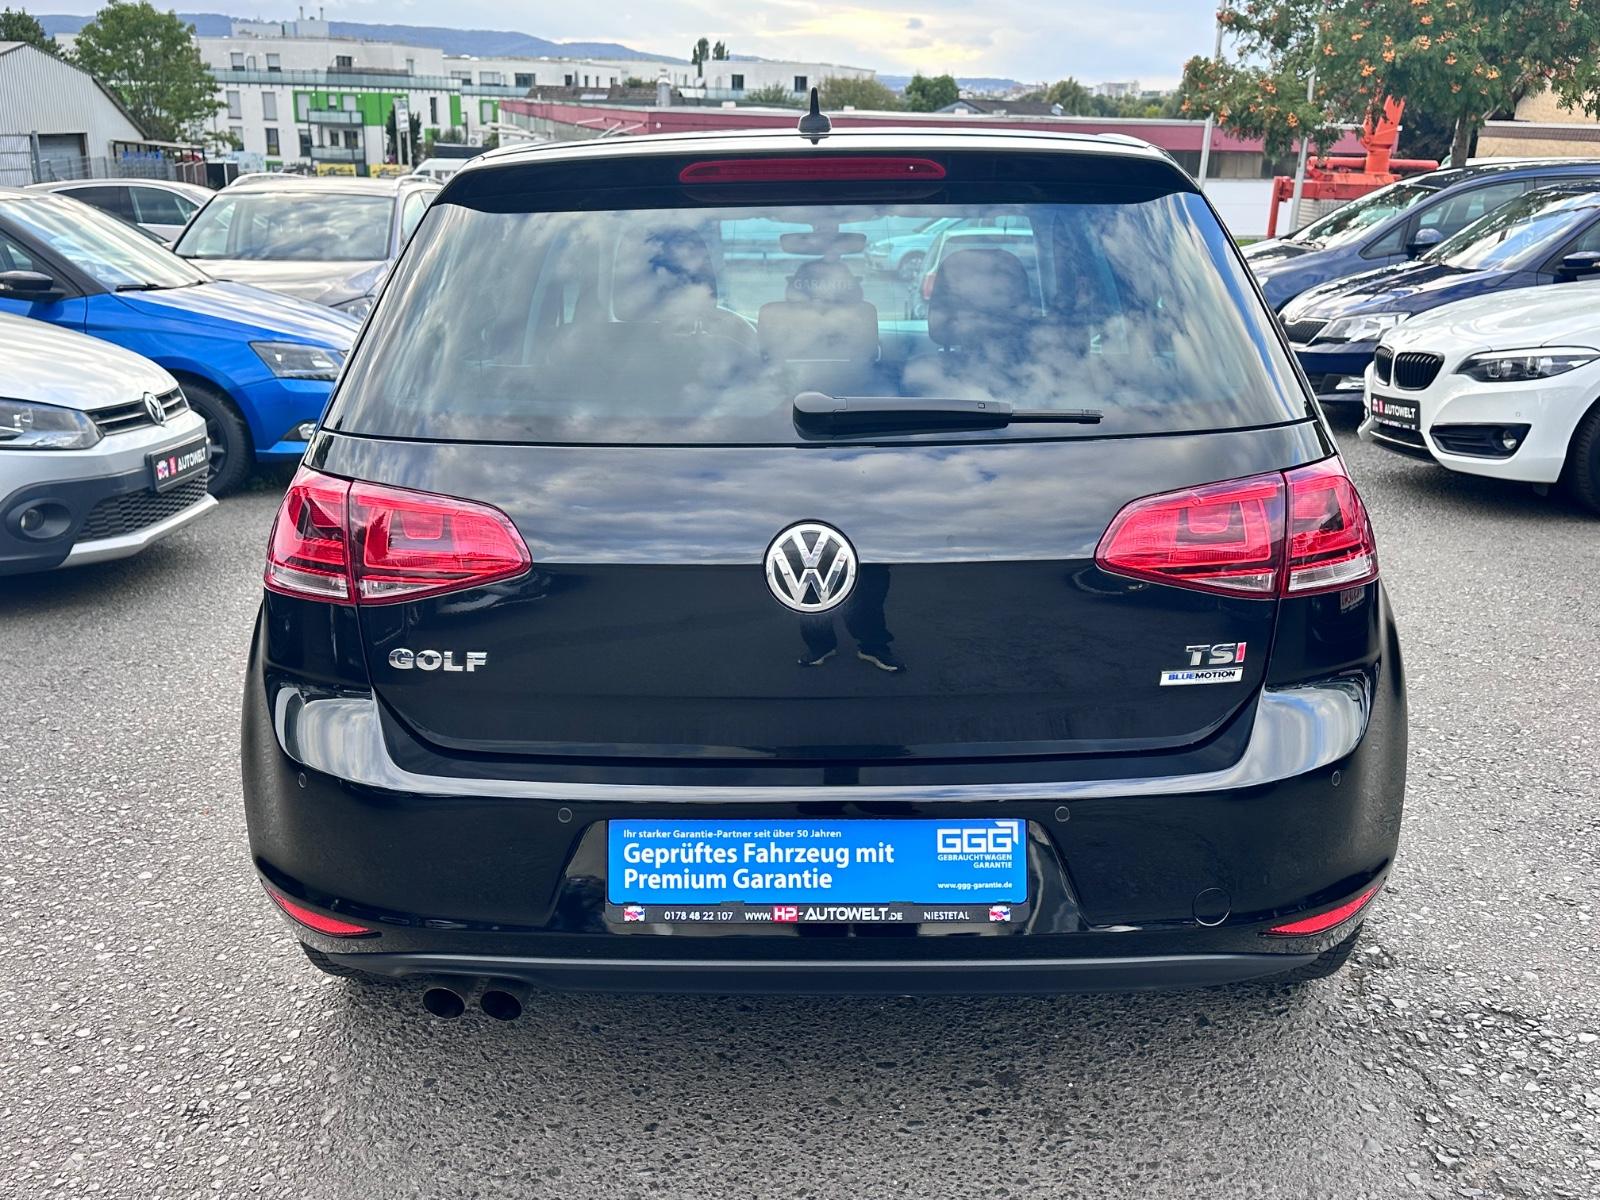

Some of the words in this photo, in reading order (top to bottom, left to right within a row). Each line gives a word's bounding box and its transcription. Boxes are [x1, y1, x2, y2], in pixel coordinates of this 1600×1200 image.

[1185, 642, 1247, 666] TSI
[388, 647, 488, 672] GOLF
[1168, 671, 1236, 680] BLUEMOTION
[623, 829, 636, 838] Ihr
[638, 829, 671, 838] starker
[673, 829, 751, 838] Garantie-Partner
[753, 829, 771, 838] seit
[773, 829, 794, 838] über
[797, 829, 808, 838] 50
[810, 829, 842, 838] Jahren
[937, 828, 1012, 853] GGG
[623, 841, 738, 869] Geprüftes
[743, 841, 850, 869] Fahrzeug
[855, 841, 895, 863] mit
[937, 853, 1013, 861] GEBRAUCHTWAGEN
[973, 861, 1013, 869] GARANTIE
[624, 867, 727, 889] Premium
[732, 867, 833, 889] Garantie
[937, 881, 1013, 890] www.ggg-garantie.de
[664, 911, 687, 921] 0178
[688, 911, 701, 921] 48
[702, 911, 714, 921] 22
[717, 911, 733, 921] 107
[923, 911, 970, 920] NIESTETAL
